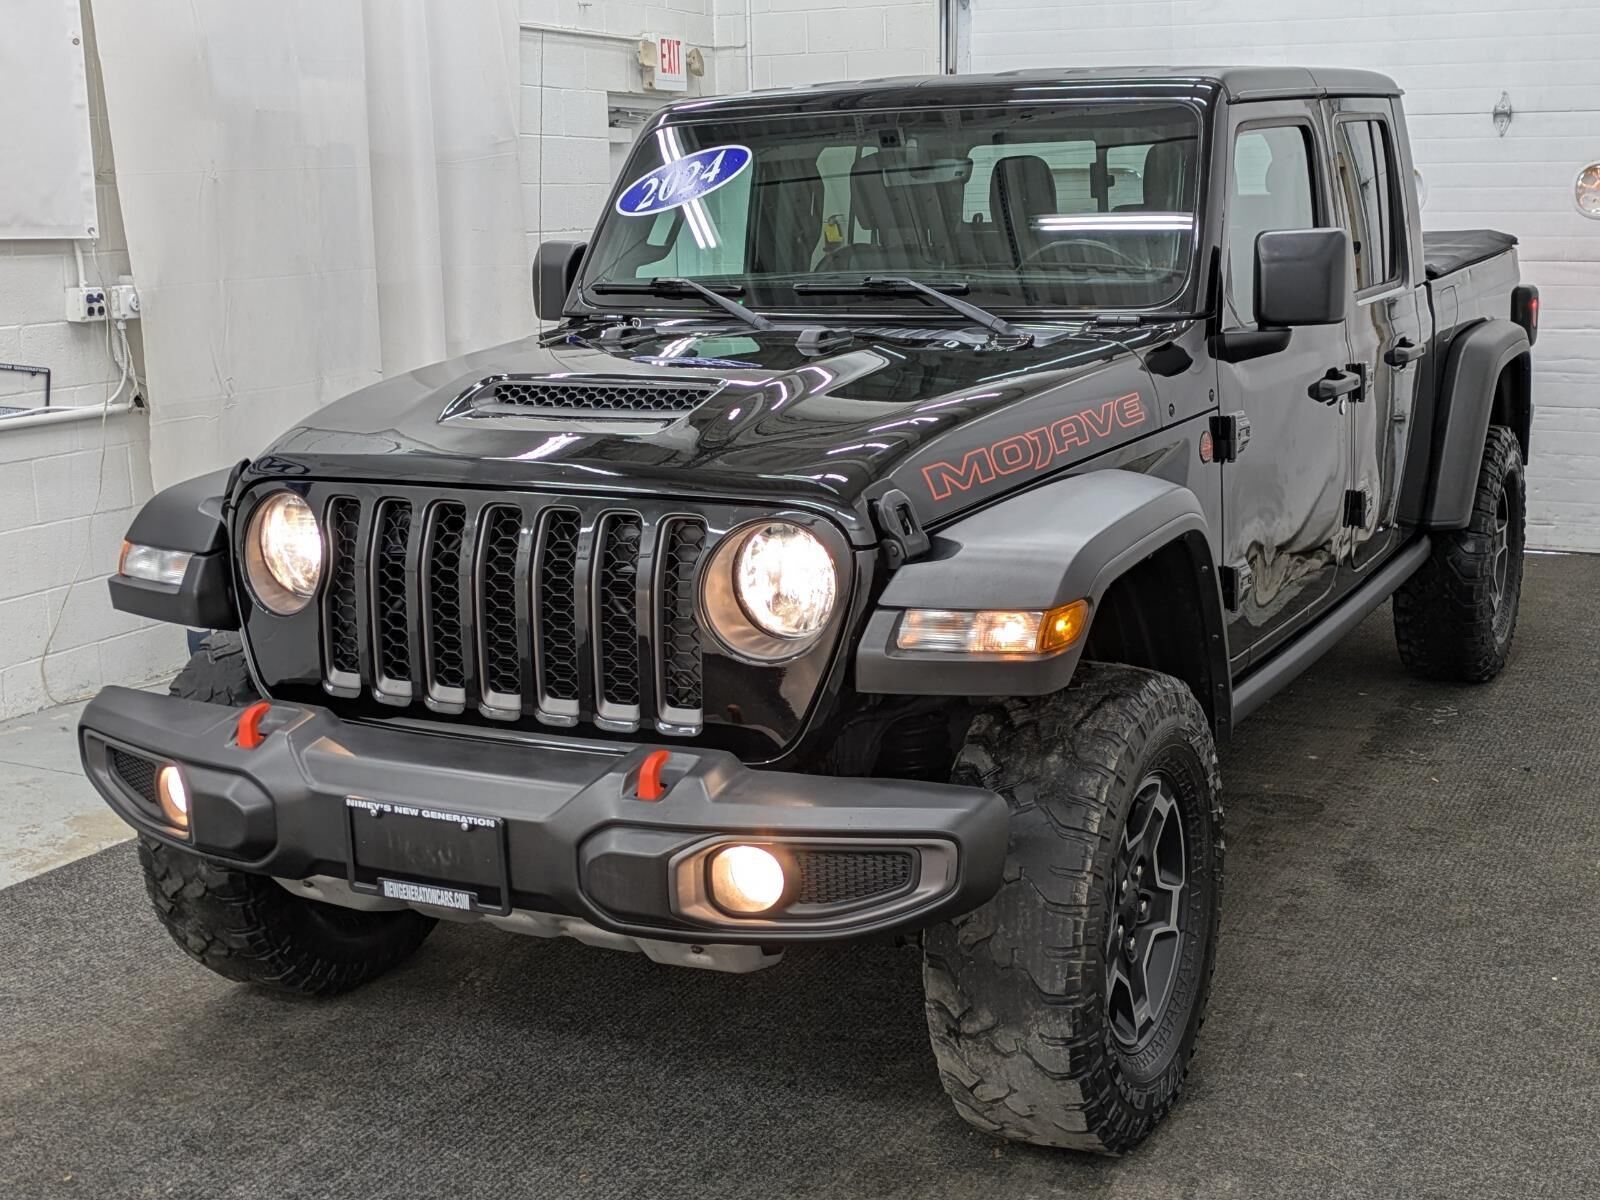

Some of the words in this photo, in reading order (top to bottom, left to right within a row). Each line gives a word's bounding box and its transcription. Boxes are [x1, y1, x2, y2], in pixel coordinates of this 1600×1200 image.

[660, 38, 681, 75] EXIT
[633, 150, 727, 212] 2024
[922, 392, 1145, 500] MOJAVE
[346, 799, 391, 812] NIMEY'S
[394, 805, 419, 817] NEW
[421, 809, 495, 828] GENERATION
[383, 880, 470, 911] NEWGENERATIONCARS.COM
